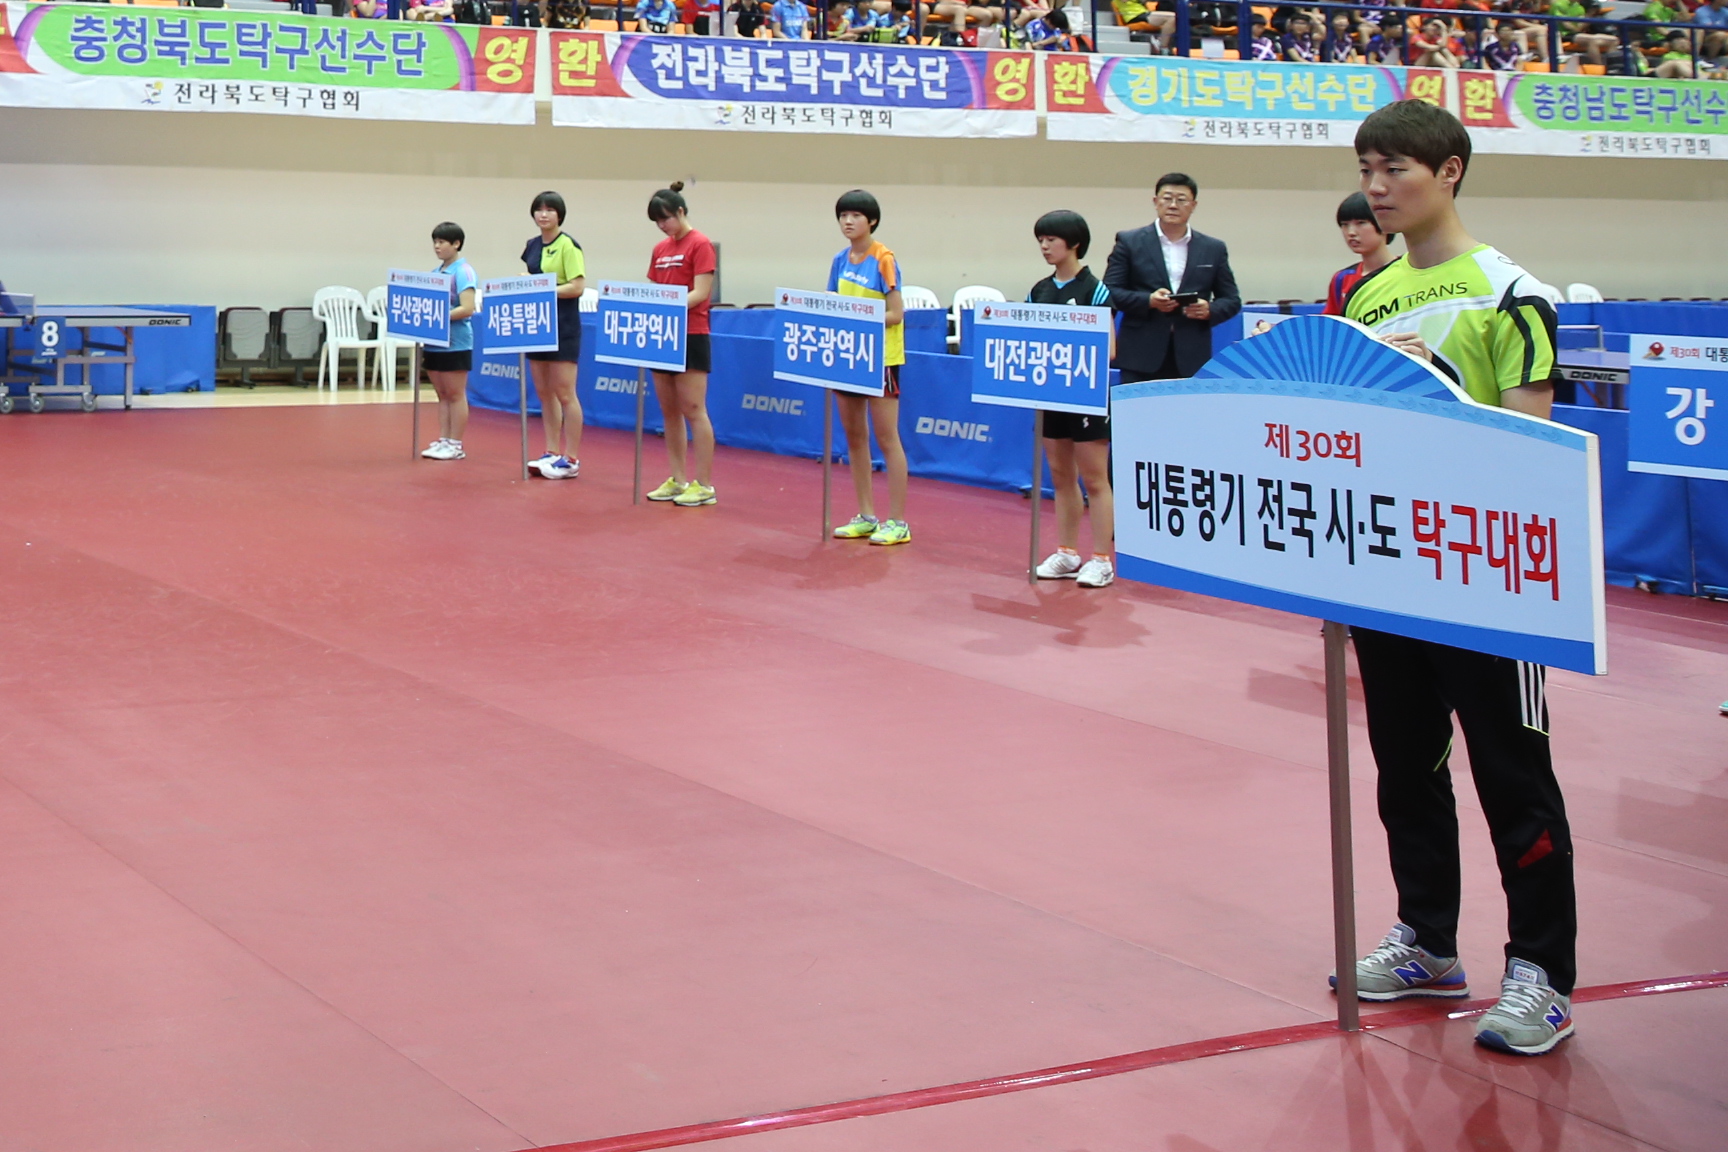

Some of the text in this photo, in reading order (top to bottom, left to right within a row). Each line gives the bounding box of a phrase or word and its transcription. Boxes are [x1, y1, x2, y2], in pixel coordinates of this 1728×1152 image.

[69, 14, 428, 78] 충청북도탁구선수단
[484, 35, 530, 85] 영
[557, 38, 1030, 103] 환 전라북도탁구선수단 영
[1053, 61, 1443, 113] 환 경기도탁구선수단 영
[173, 82, 361, 112] 전라북도탁구협회
[1463, 78, 1497, 121] 환
[740, 105, 894, 130] 전라북도탁구협회
[1203, 119, 1331, 140] 전라북도탁구협회
[1598, 135, 1712, 156] 전라북도탁구협회
[149, 318, 183, 326] DONIC
[390, 293, 446, 331] 부산광역시
[488, 301, 551, 337] 서울특별시
[1357, 282, 1469, 328] IOM TRANS
[41, 320, 60, 348] 8
[603, 309, 680, 351] 대구광역시
[782, 321, 876, 373] 광주광역시
[984, 337, 1098, 390] 대전광역시
[1669, 346, 1701, 359] 제30회
[1569, 370, 1618, 382] DONIC
[741, 393, 804, 416] DONIC
[1665, 386, 1715, 446] 강
[915, 416, 990, 443] DONIC
[1264, 421, 1363, 469] 제30회
[1134, 460, 1561, 603] 대통령기 전국 시·도 탁구대회
